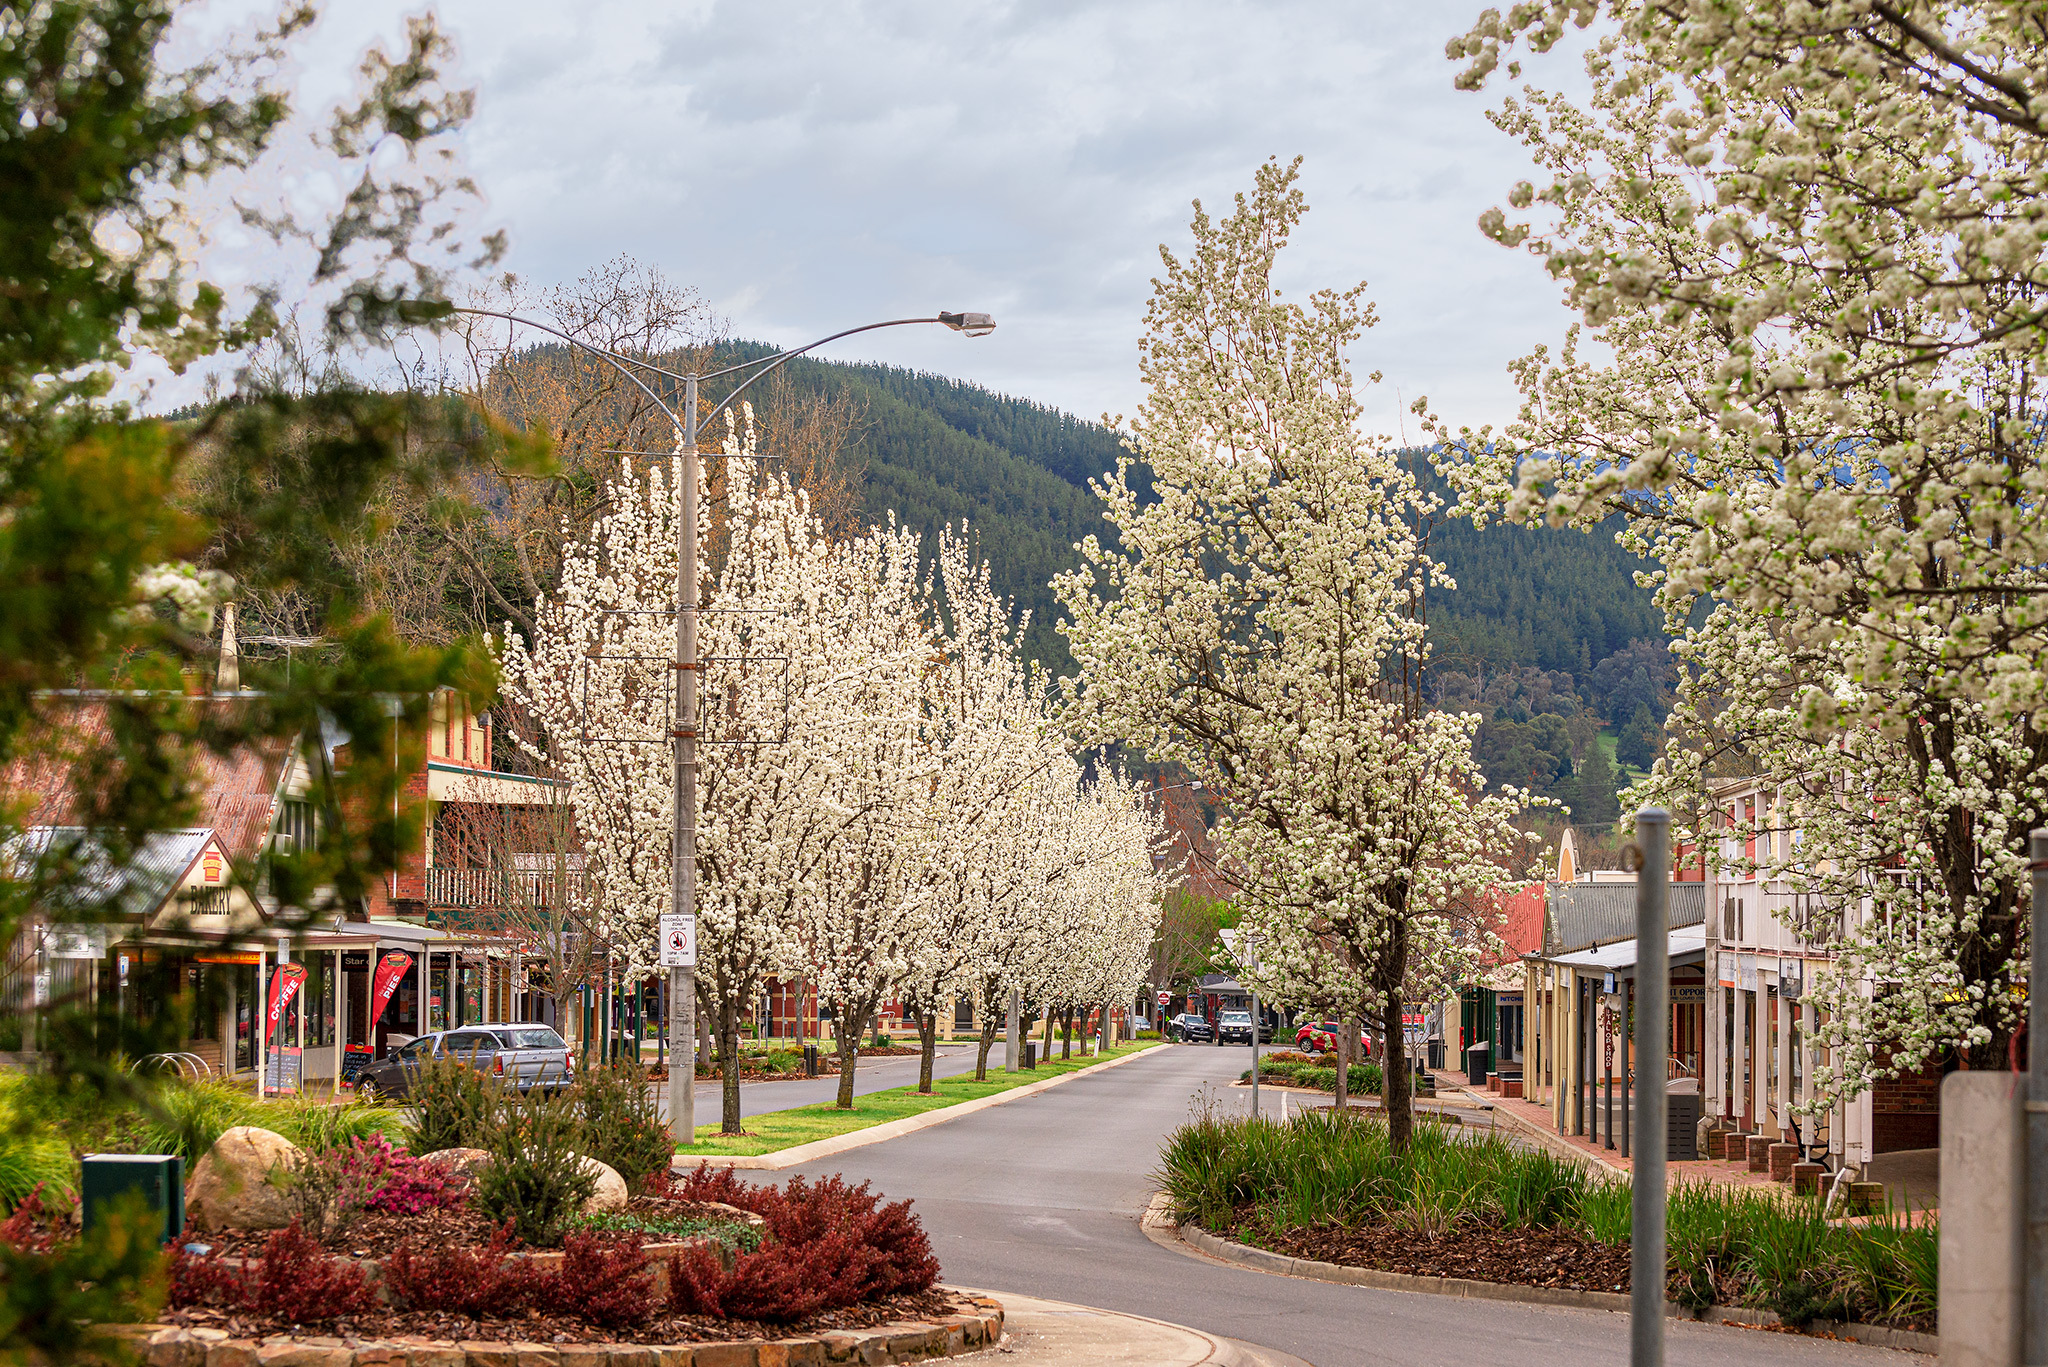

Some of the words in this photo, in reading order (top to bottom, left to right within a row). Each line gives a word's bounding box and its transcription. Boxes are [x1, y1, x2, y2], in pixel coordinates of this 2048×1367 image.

[190, 885, 232, 915] BAKERY
[345, 957, 364, 965] Star
[383, 975, 400, 999] PIES
